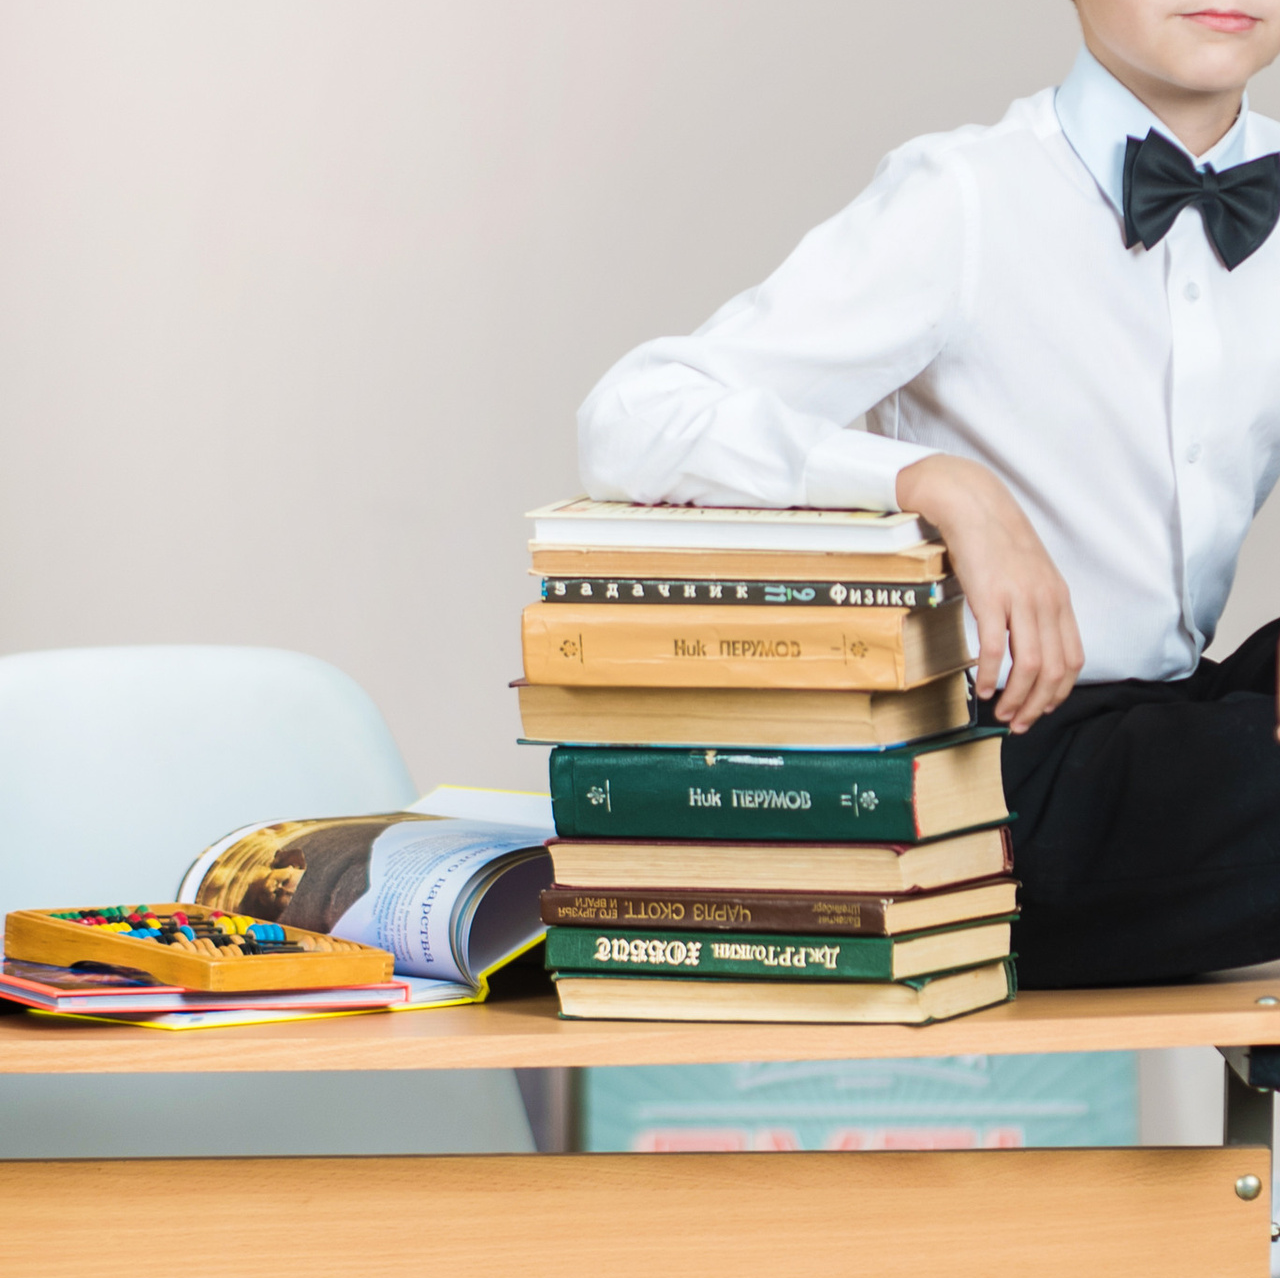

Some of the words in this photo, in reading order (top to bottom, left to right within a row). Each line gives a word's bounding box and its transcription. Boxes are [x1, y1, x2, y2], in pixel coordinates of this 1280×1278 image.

[829, 583, 916, 606] Физика
[673, 639, 706, 658] Ник
[719, 639, 802, 659] ПЕРУМОВ
[688, 787, 722, 807] Ник
[731, 789, 812, 810] ПЕРУМОВ
[557, 907, 596, 919] ДРУЗЬЯ
[598, 907, 620, 919] ЕГО
[692, 903, 752, 923] ЧАРЛЗ
